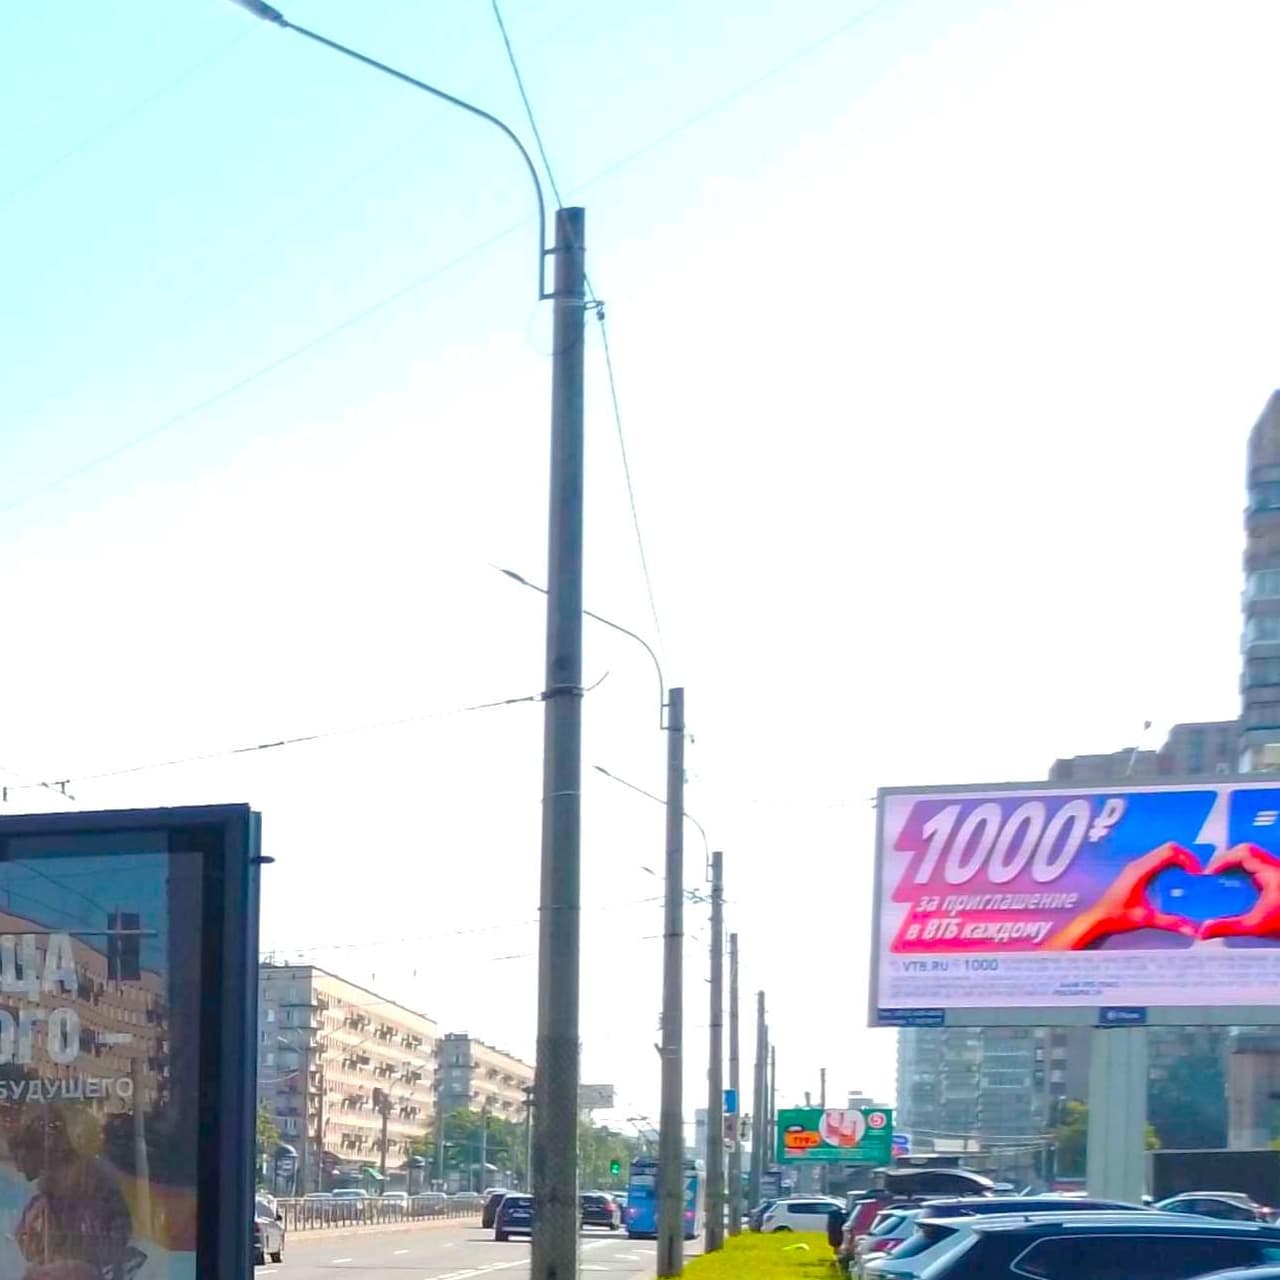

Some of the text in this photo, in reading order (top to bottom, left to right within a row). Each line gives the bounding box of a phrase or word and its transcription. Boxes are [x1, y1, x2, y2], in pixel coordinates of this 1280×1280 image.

[916, 892, 1079, 916] за приглашение
[905, 918, 1054, 944] в ВТБ каждому
[965, 959, 999, 972] 1000
